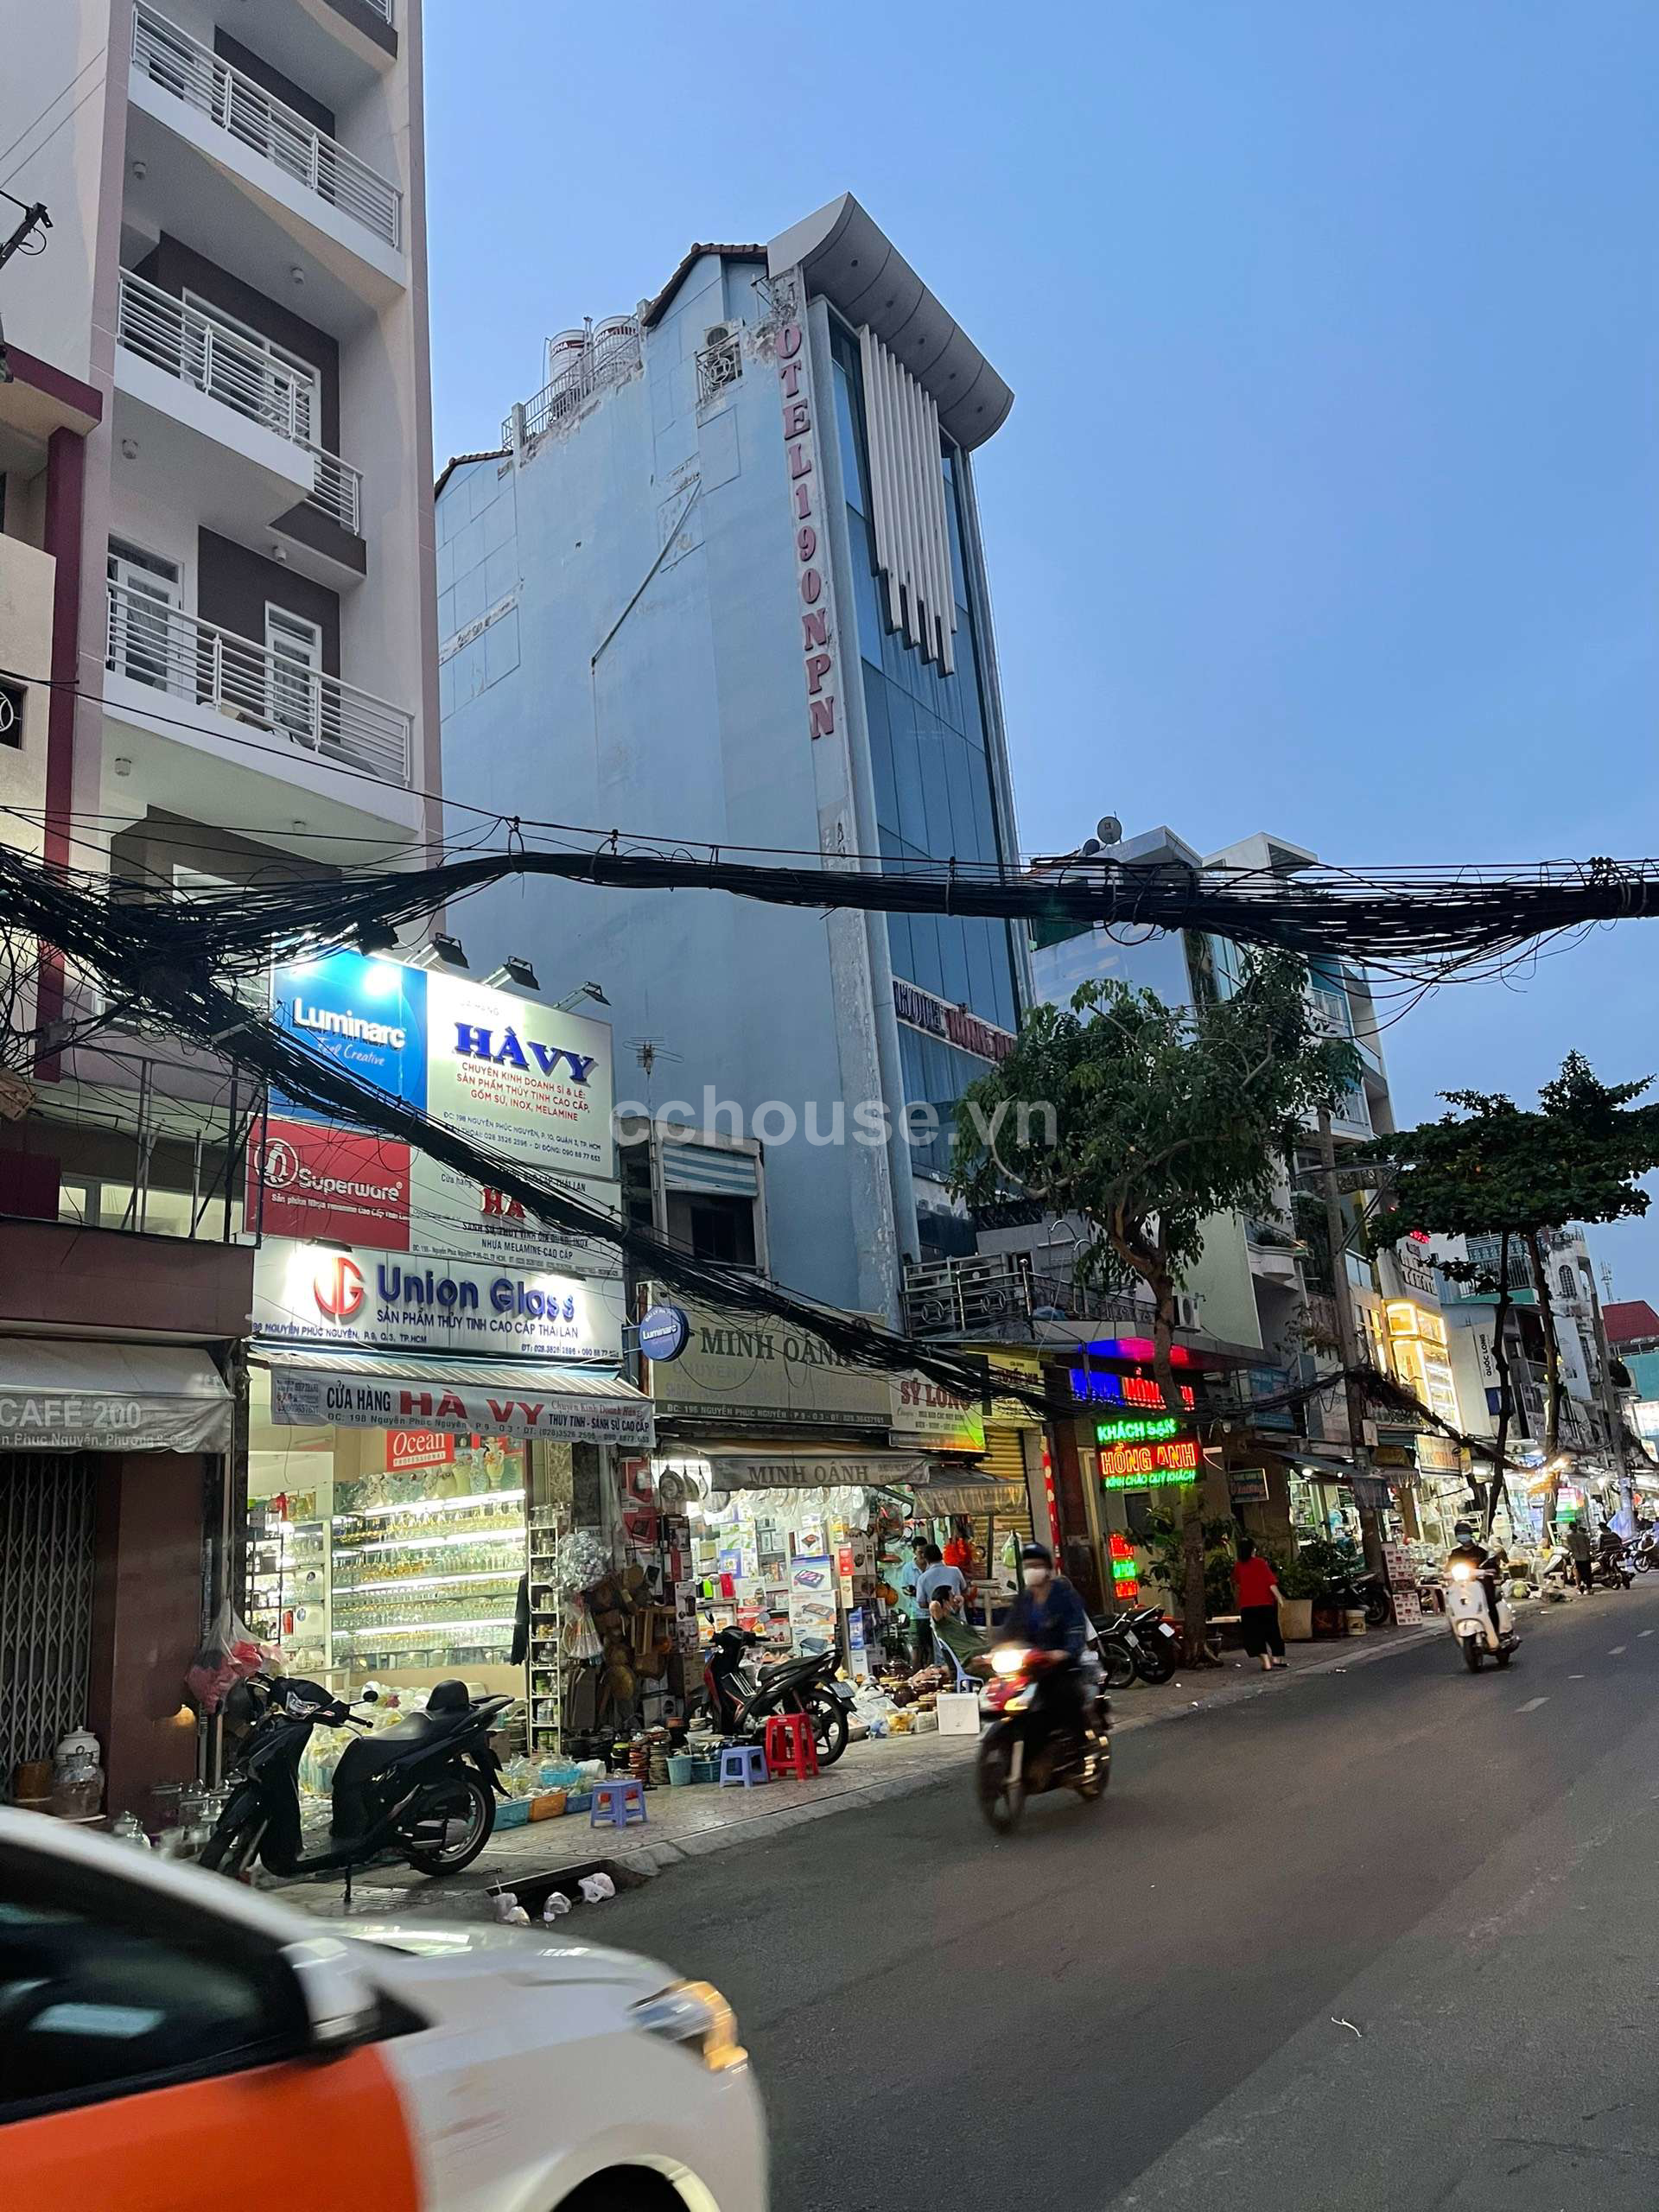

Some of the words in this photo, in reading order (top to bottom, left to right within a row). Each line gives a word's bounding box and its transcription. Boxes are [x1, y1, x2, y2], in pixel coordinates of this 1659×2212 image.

[293, 997, 406, 1049] Luminarc
[344, 1044, 385, 1066] Creative
[461, 1062, 499, 1078] CHUYÊN
[501, 1071, 522, 1084] KINH
[524, 1077, 555, 1092] DOANH
[510, 1099, 534, 1112] INOX,
[536, 1104, 578, 1122] MELAMINE
[531, 1090, 550, 1103] TINH
[553, 1096, 570, 1108] CAO
[298, 1167, 400, 1202] Superware
[378, 1264, 479, 1310] Union
[490, 1278, 575, 1321] Glass
[377, 1301, 399, 1322] SẢN
[467, 1317, 486, 1331] TINH
[490, 1319, 512, 1332] CAO
[560, 1325, 579, 1339] LAN
[642, 1324, 678, 1340] Luminarc
[700, 1325, 776, 1360] MINH
[1479, 1333, 1488, 1354] LONG
[327, 1379, 353, 1410] CỬA
[357, 1384, 391, 1413] HÀNG
[399, 1388, 468, 1421] HÀ
[486, 1398, 545, 1426] VY
[92, 1401, 142, 1429] 200
[569, 1415, 586, 1428] TINH
[622, 1420, 635, 1432] CAO
[1096, 1420, 1146, 1442] KHÁCH
[1146, 1418, 1176, 1440] SẠN
[393, 1432, 446, 1456] Ocean
[1156, 1443, 1197, 1469] ANH
[394, 1452, 445, 1466] PROFESSIONAL
[747, 1465, 808, 1484] MINH
